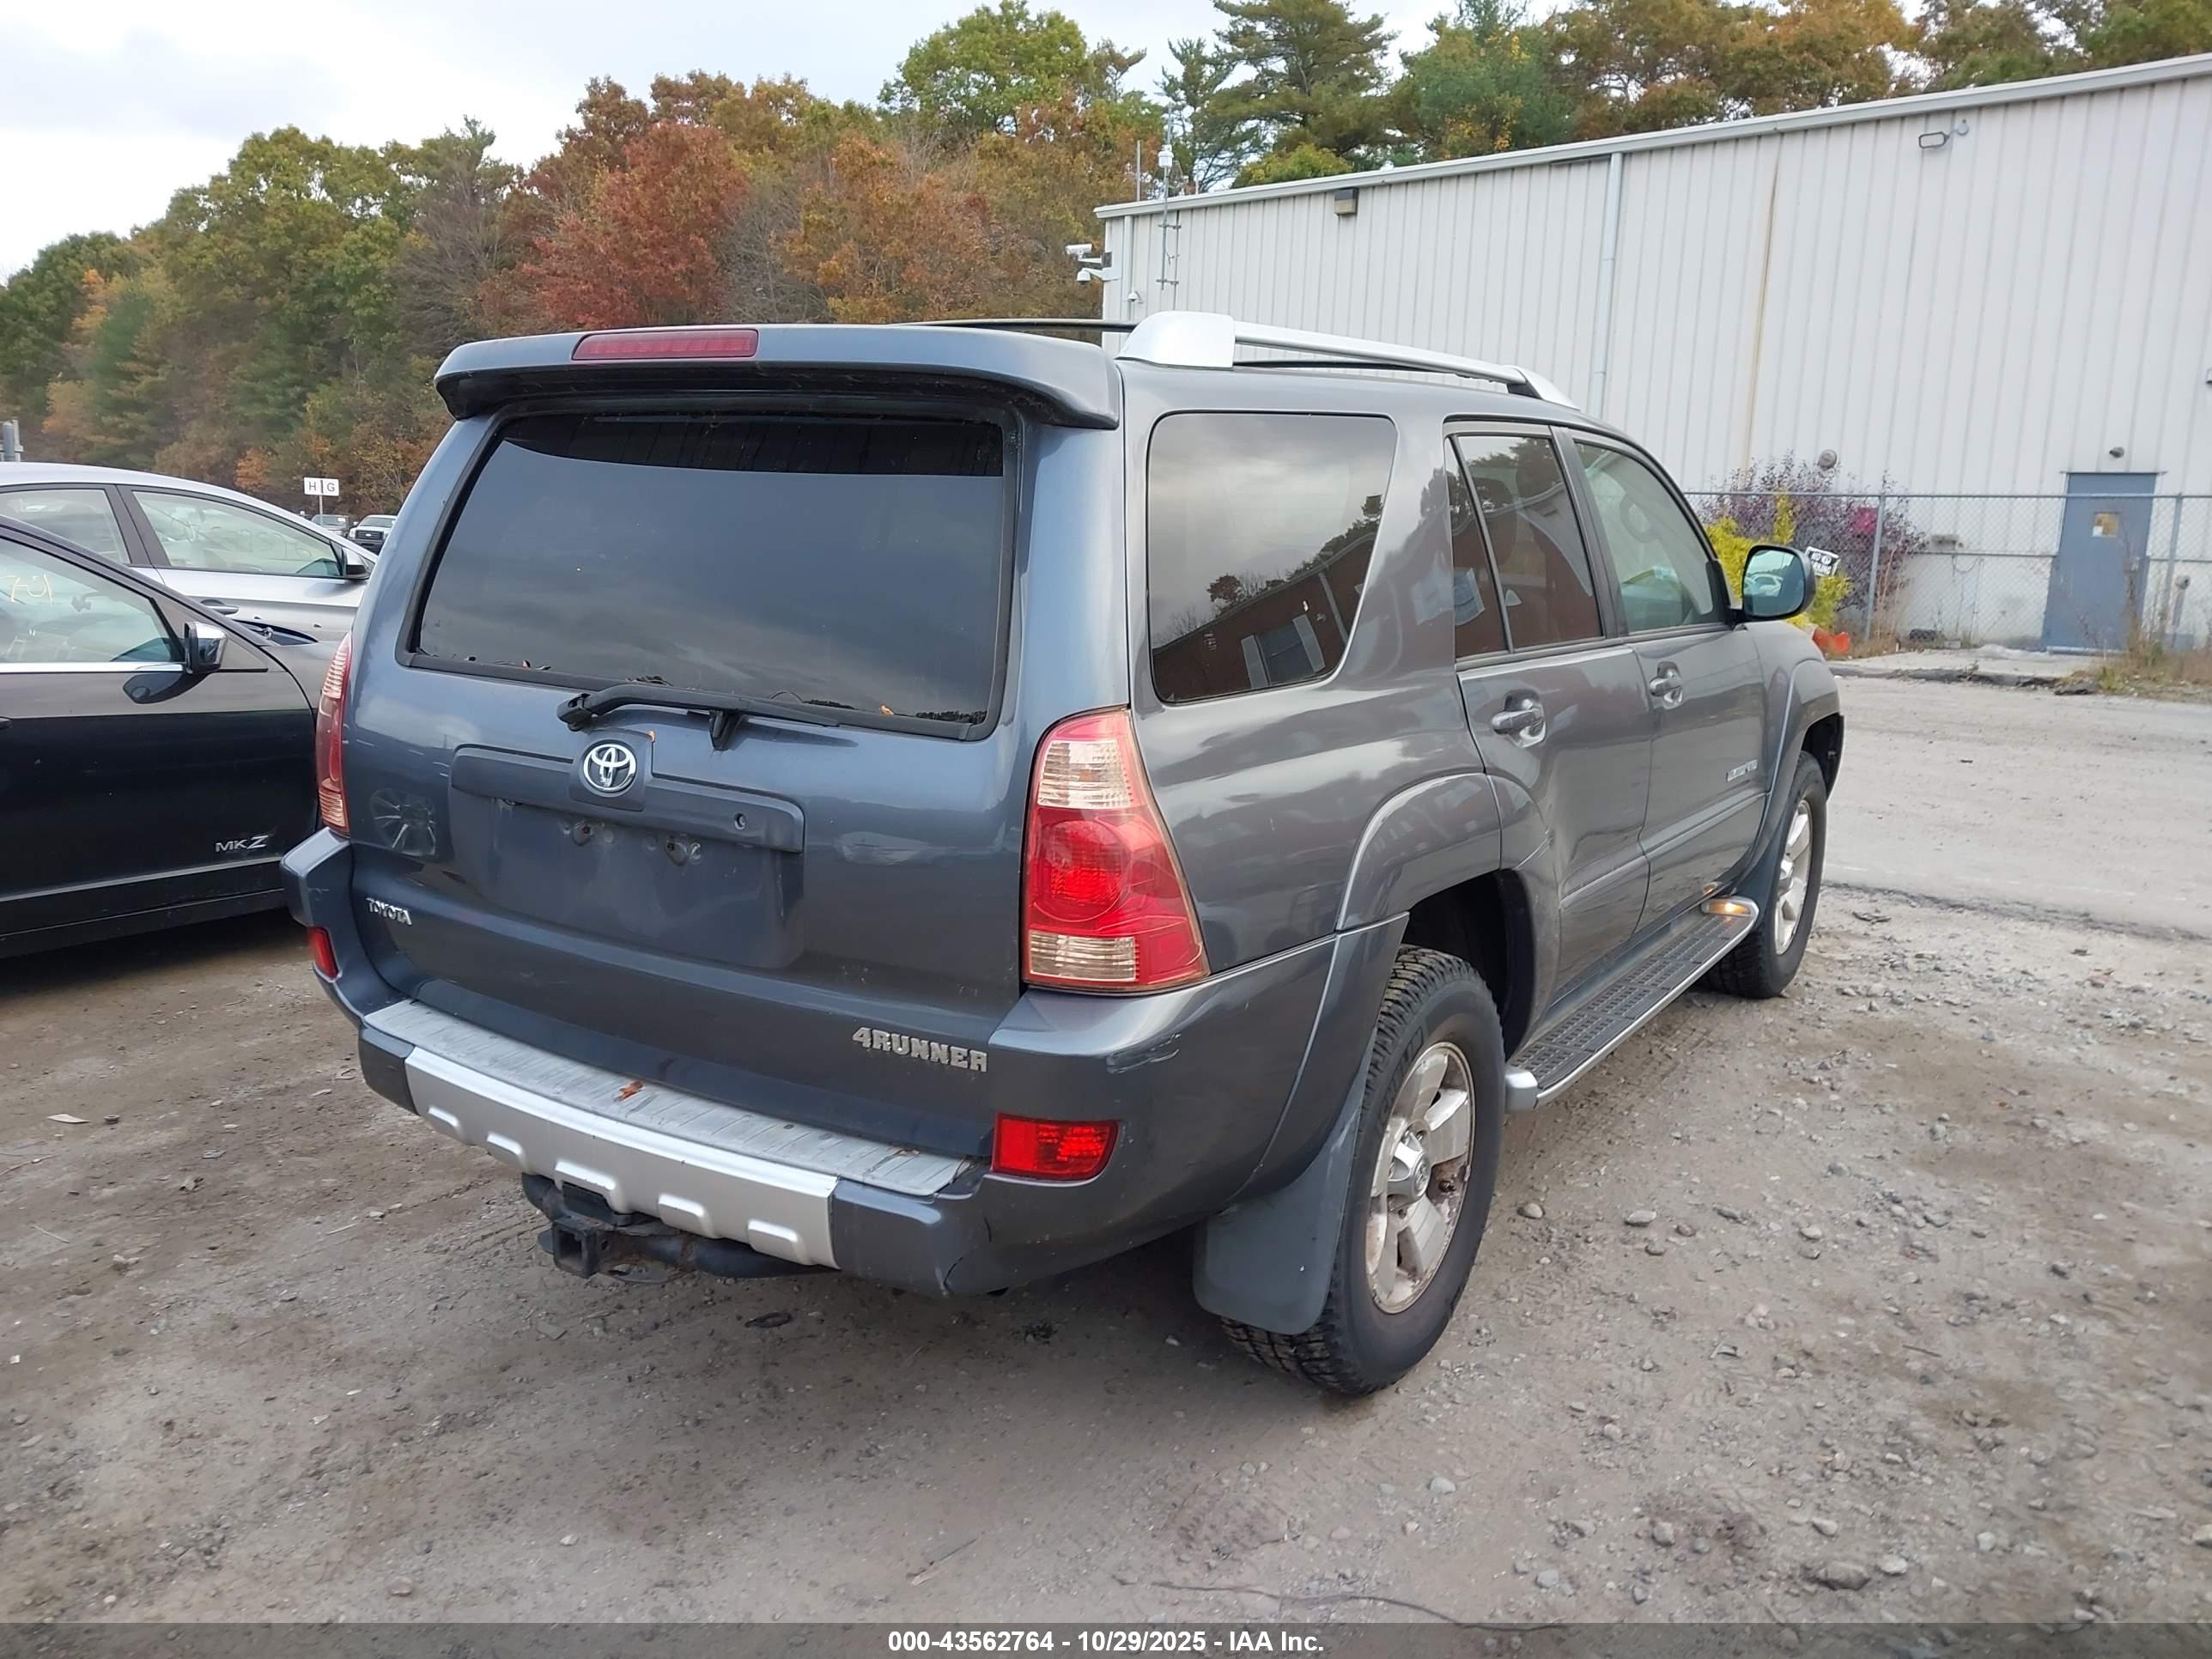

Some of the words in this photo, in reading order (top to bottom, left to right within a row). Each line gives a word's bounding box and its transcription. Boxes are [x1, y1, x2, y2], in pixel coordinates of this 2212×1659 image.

[327, 483, 335, 492] G
[216, 836, 269, 852] MKZ
[367, 897, 412, 925] TOYOTA
[853, 1027, 987, 1072] 4RUNNER
